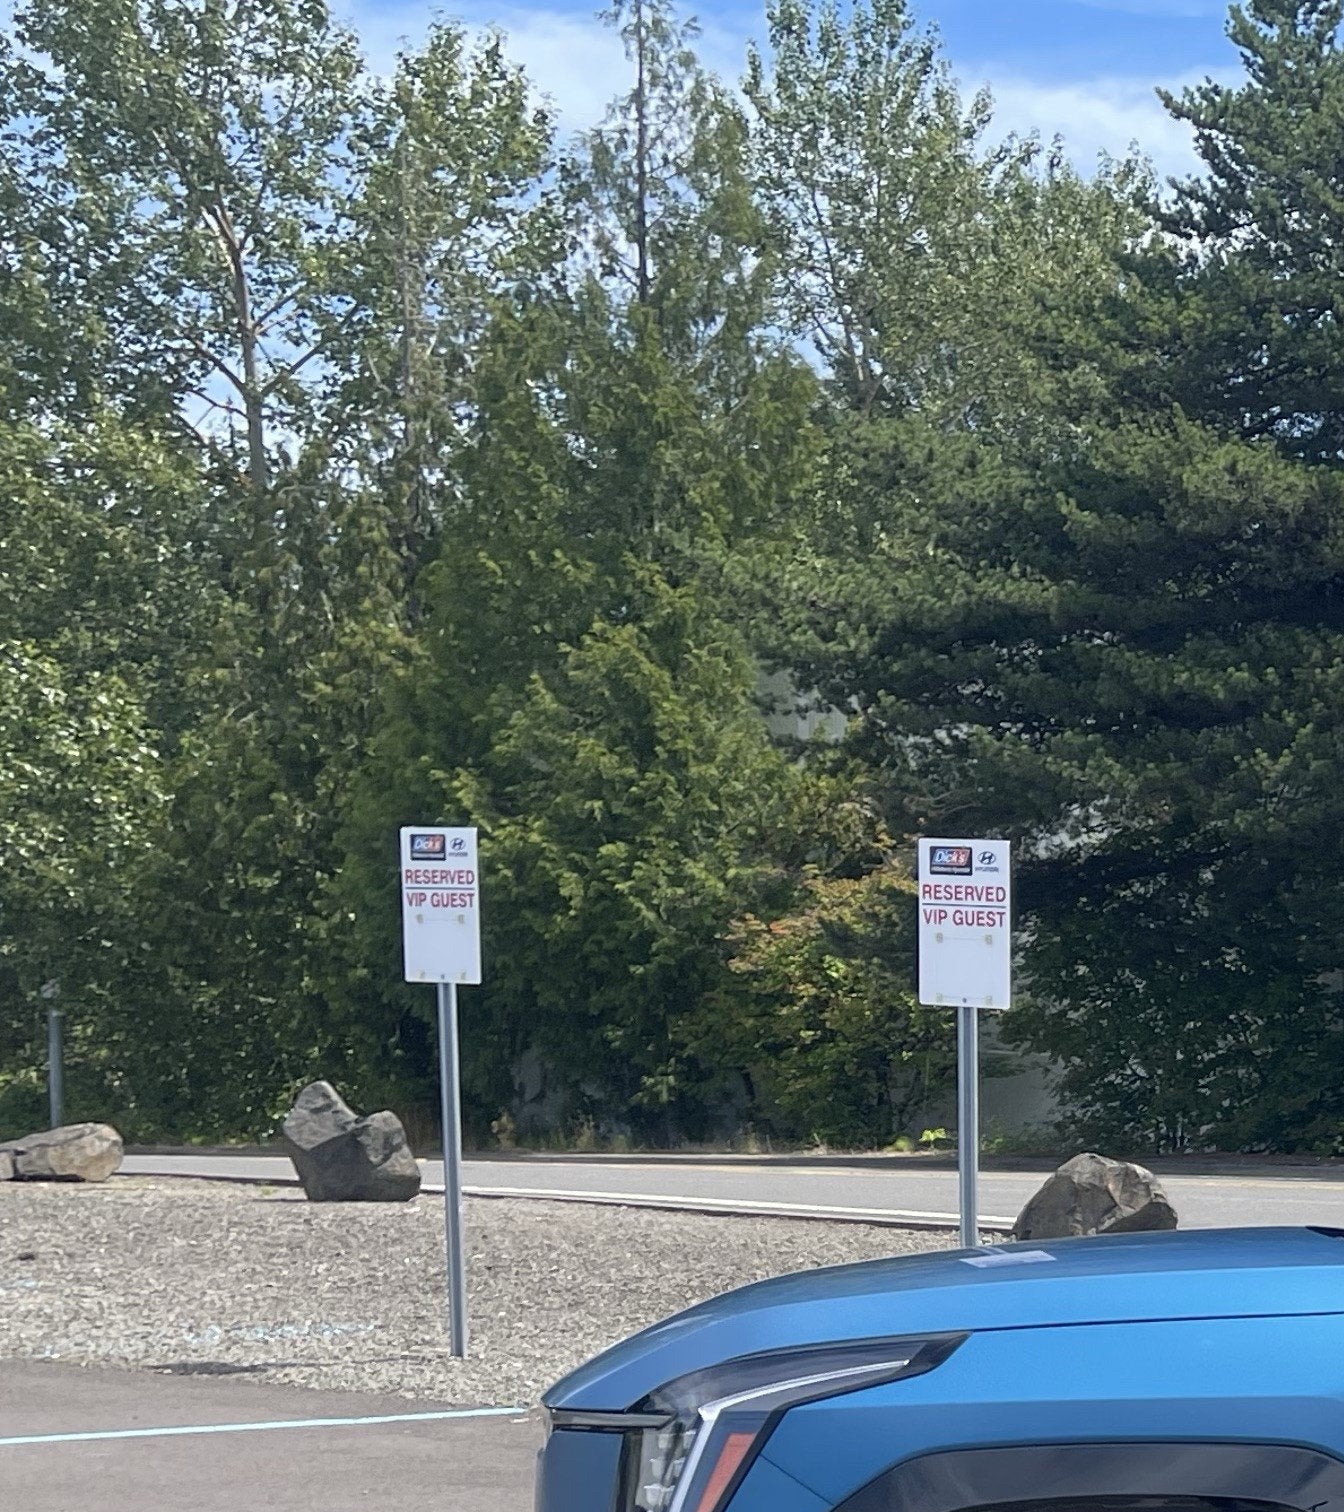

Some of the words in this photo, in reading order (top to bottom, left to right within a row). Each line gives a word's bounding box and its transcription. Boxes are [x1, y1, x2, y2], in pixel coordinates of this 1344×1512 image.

[404, 869, 475, 885] RESERVED
[406, 892, 427, 908] VIP
[430, 892, 475, 908] GUEST
[922, 884, 1006, 903] RESERVED
[923, 908, 948, 925] VIP
[952, 909, 1006, 928] GUEST
